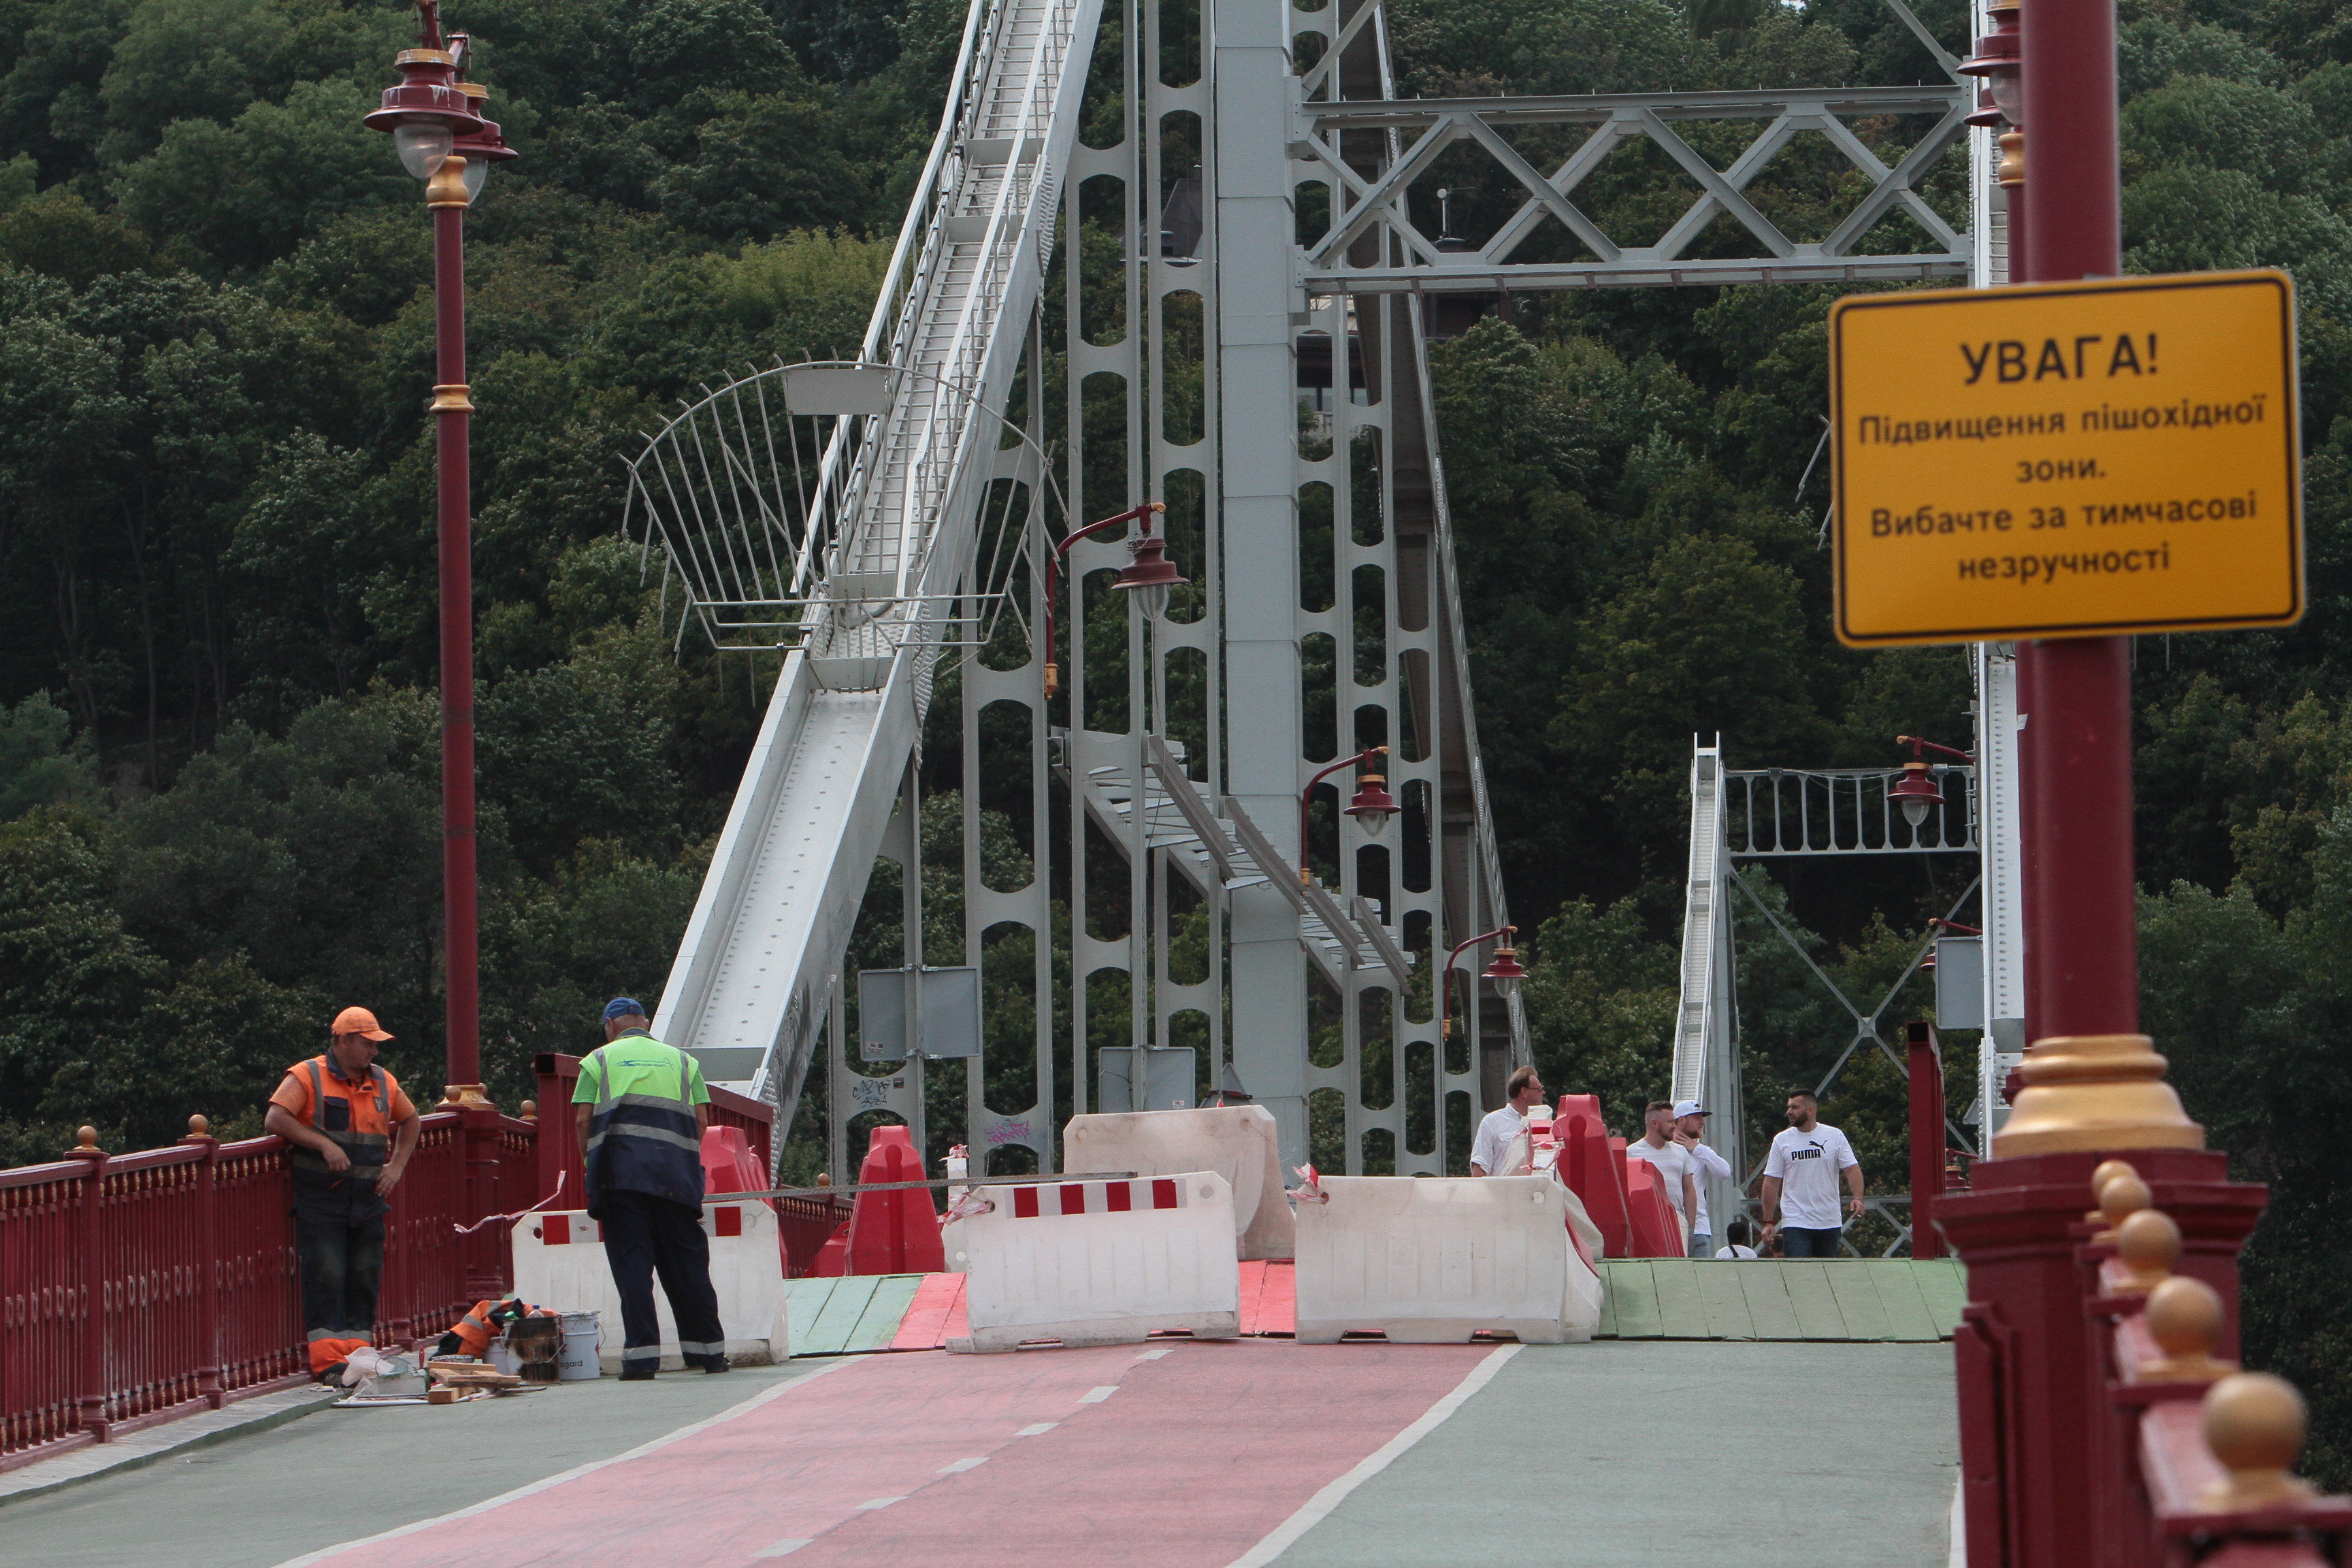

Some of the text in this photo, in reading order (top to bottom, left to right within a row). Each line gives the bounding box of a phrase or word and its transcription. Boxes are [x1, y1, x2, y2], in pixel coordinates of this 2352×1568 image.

[1959, 332, 2159, 385] УВАГА!
[1859, 394, 2267, 446] Підвищення пішохідної
[2017, 458, 2106, 484] зони.
[1871, 491, 2257, 538] Вибачте за тимчасові
[1958, 542, 2170, 585] незручності
[1791, 1149, 1821, 1161] PUMA
[560, 1360, 583, 1369] sgard
